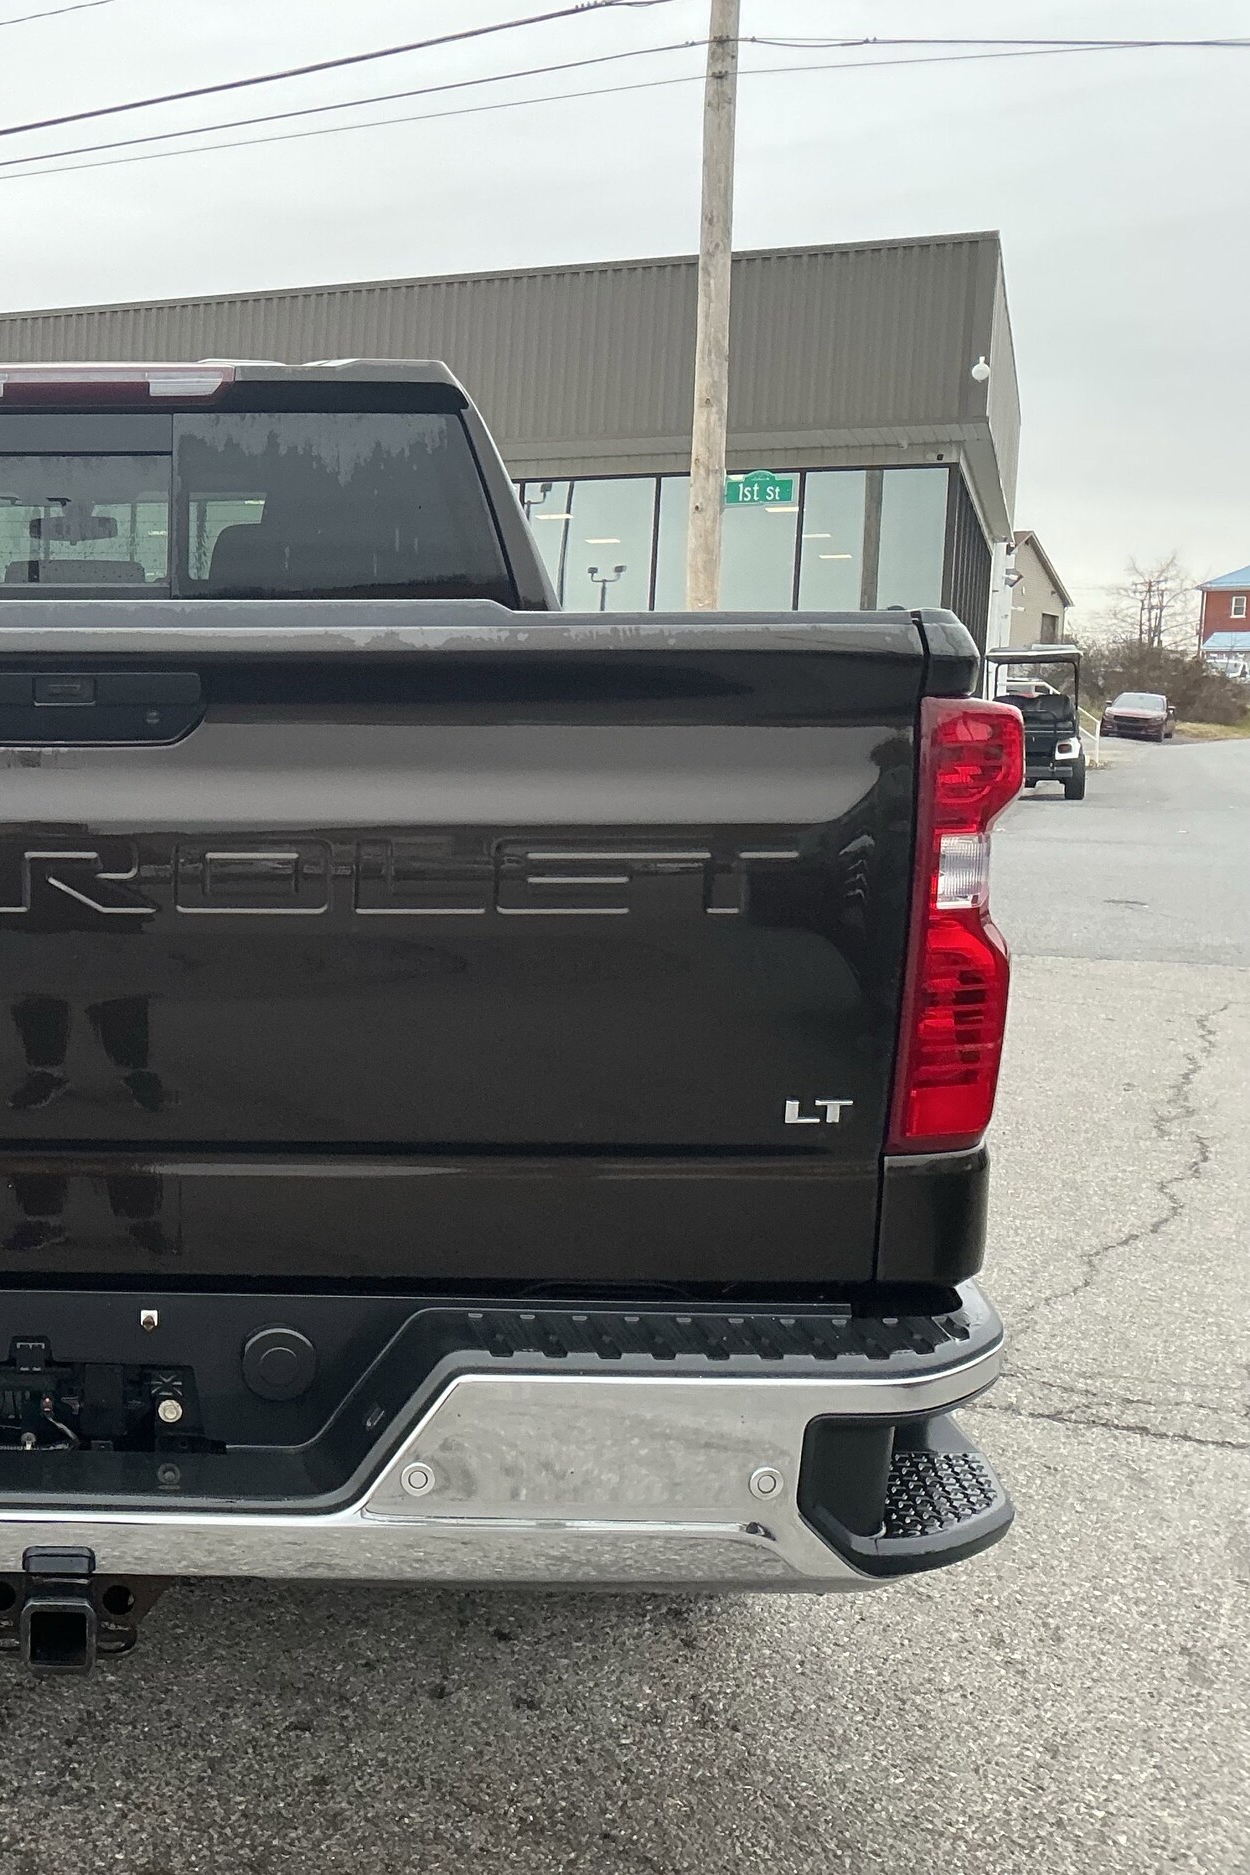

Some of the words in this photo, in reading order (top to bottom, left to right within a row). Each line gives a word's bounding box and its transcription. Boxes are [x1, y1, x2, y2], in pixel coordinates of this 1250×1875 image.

[738, 482, 759, 501] 1st
[766, 486, 780, 500] St
[784, 1100, 854, 1124] LT
